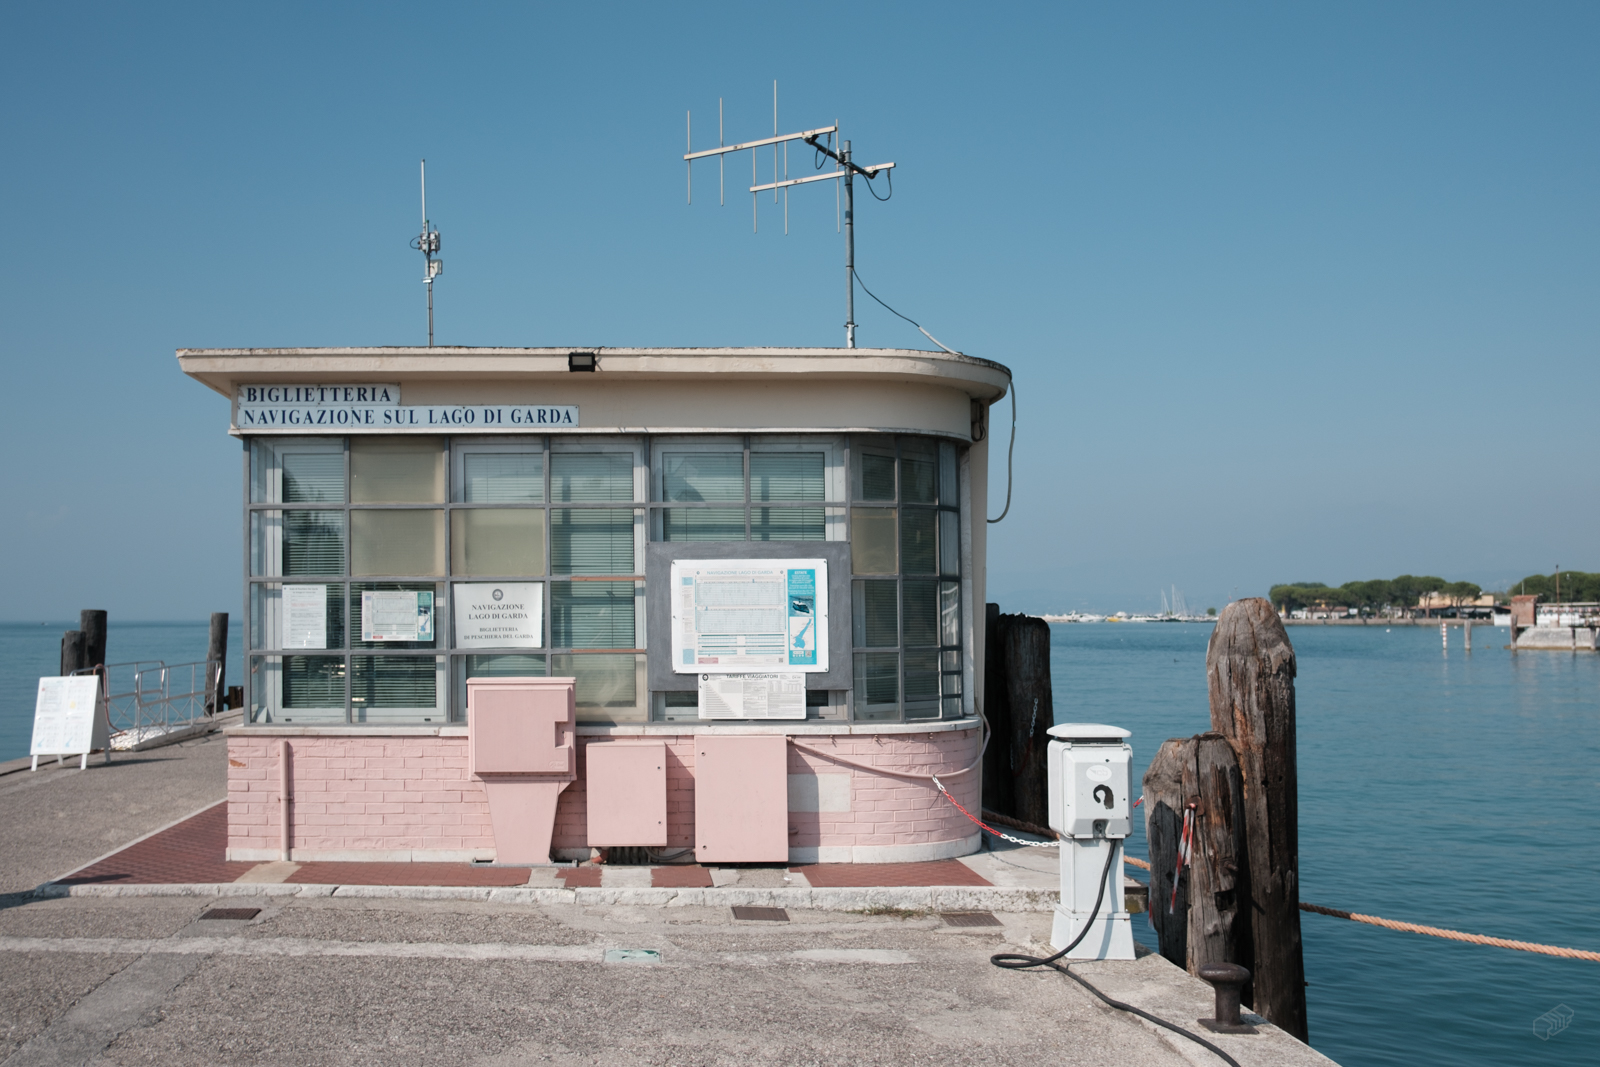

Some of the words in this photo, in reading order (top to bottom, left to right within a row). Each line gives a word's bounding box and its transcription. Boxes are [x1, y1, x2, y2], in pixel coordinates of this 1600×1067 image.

[247, 387, 392, 403] BIGLIETTERIA
[244, 409, 375, 425] NAVIGAZIONE
[383, 409, 419, 425] SUL
[429, 409, 476, 425] LAGO
[484, 409, 503, 425] DI
[511, 409, 573, 425] GARDA
